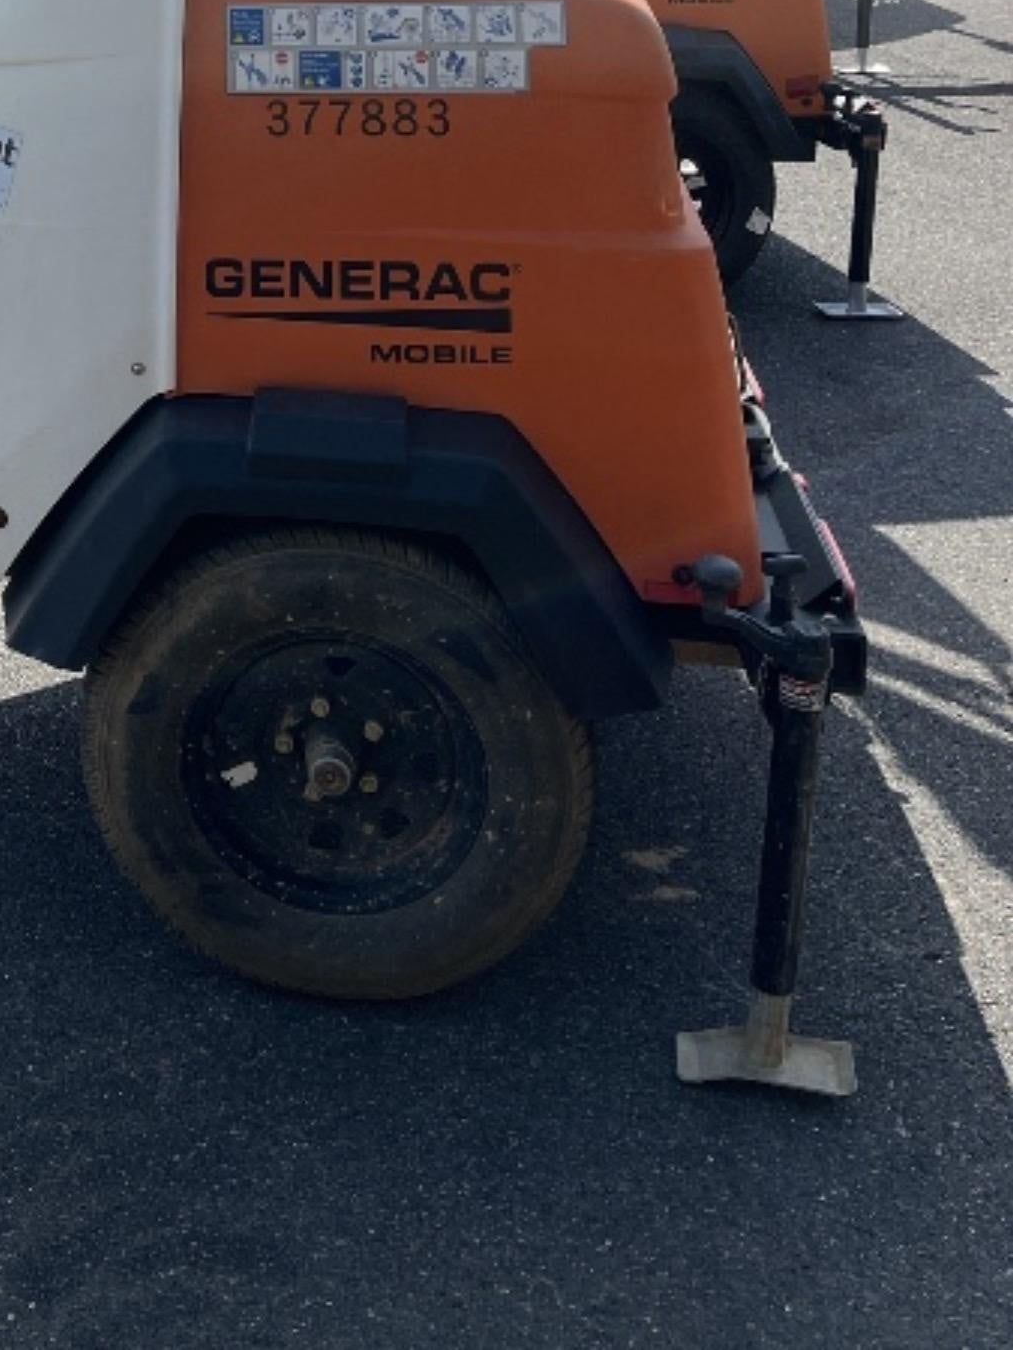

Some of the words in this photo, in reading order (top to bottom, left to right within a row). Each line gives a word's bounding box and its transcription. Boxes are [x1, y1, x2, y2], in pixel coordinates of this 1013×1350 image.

[266, 98, 451, 137] 377883
[205, 258, 510, 301] GENERAC
[371, 343, 513, 364] MOBILE
